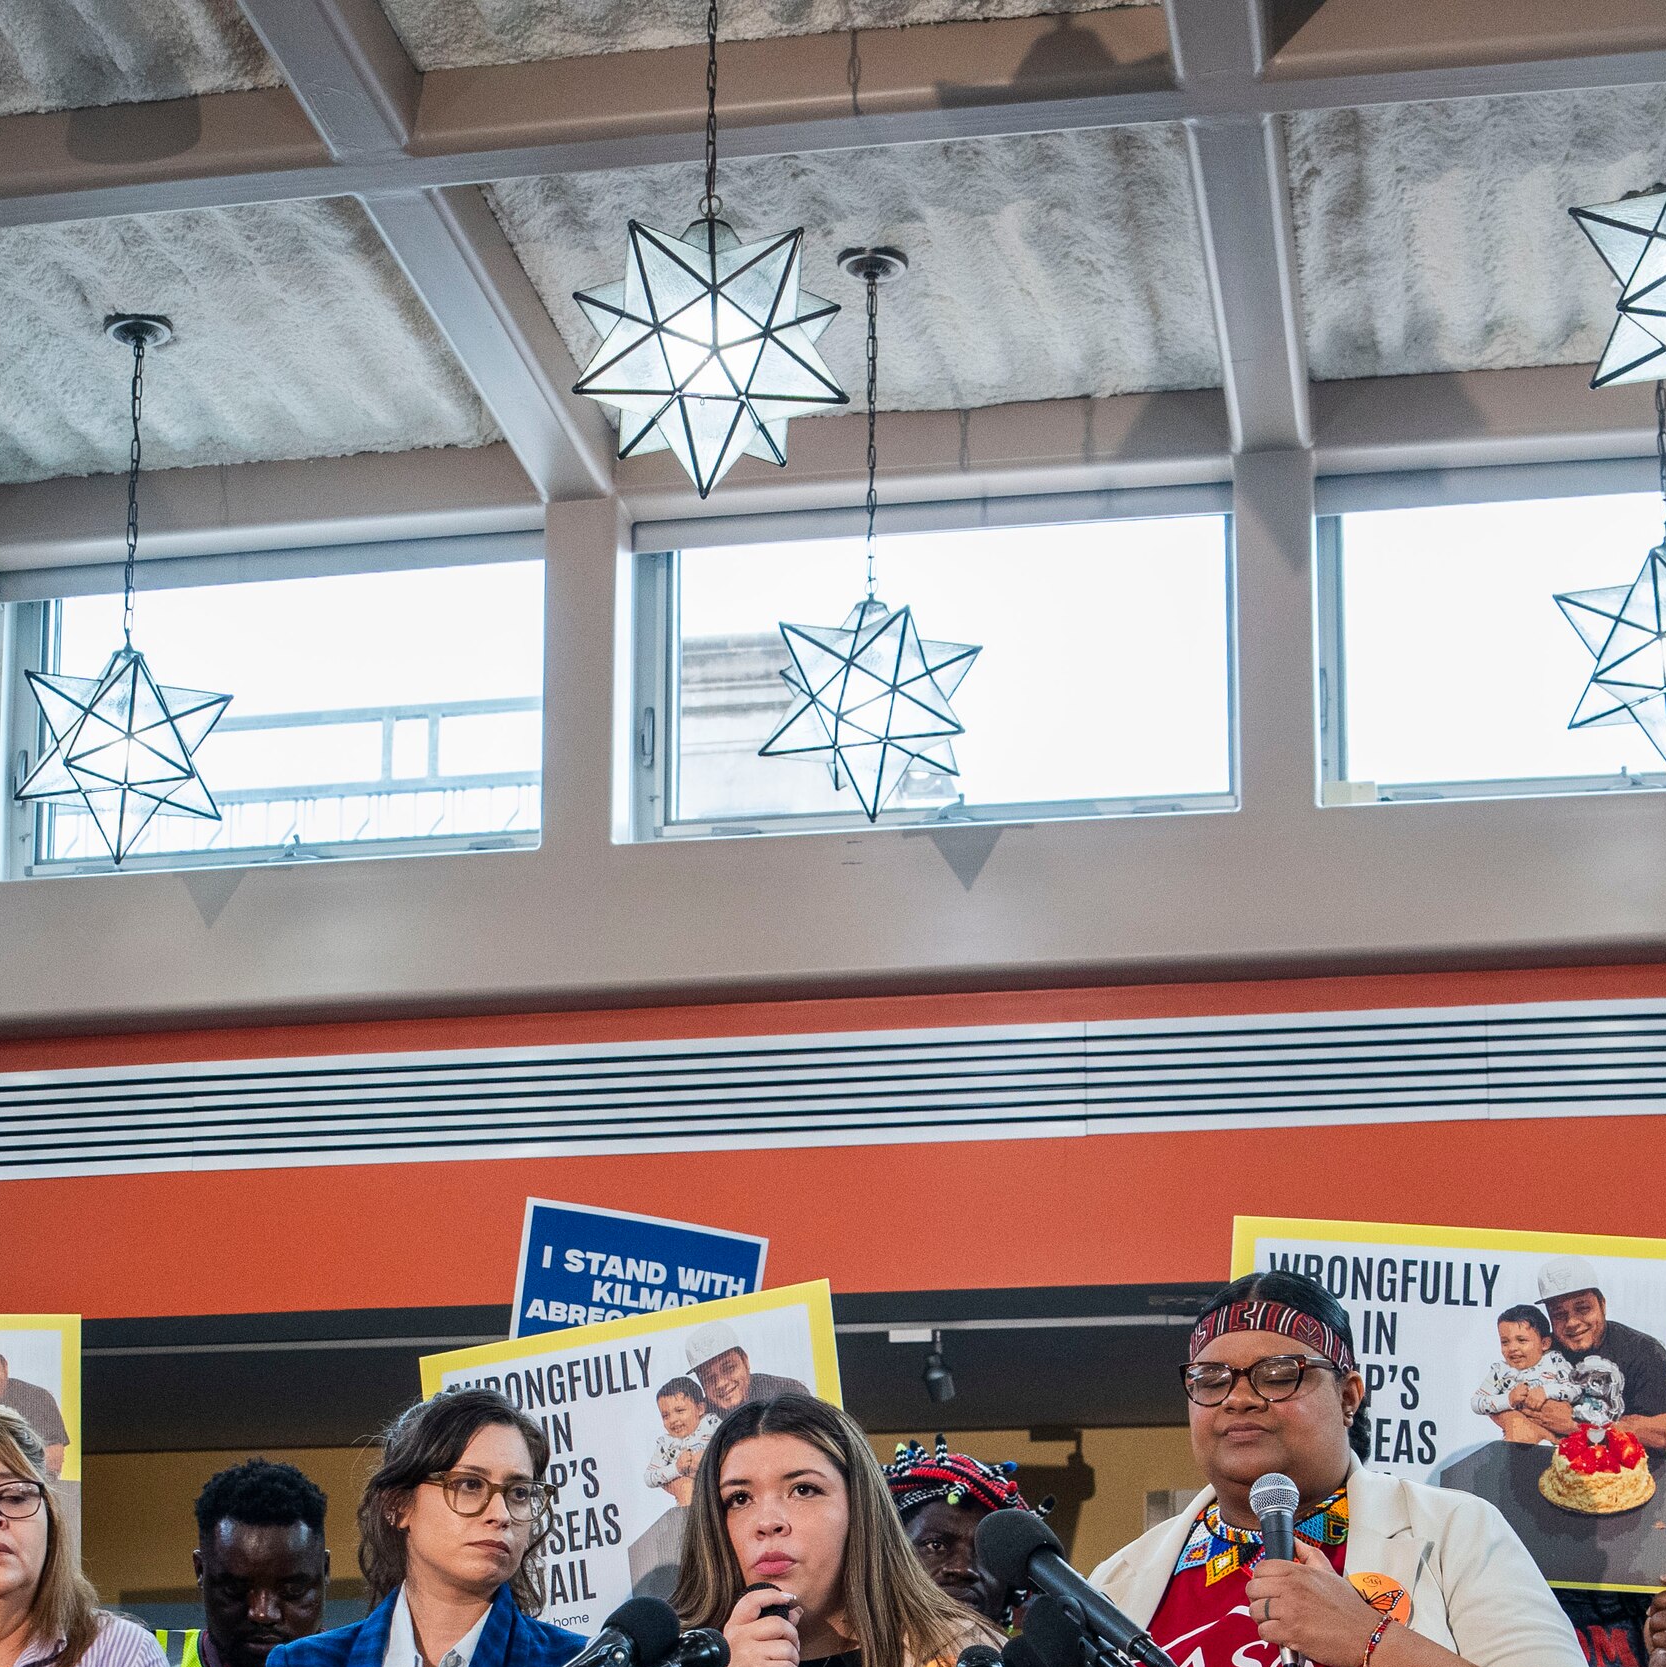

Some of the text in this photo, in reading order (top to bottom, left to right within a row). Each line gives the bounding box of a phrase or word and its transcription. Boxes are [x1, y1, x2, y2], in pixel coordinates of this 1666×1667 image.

[541, 1245, 747, 1297] I STAND WITH
[1362, 1310, 1397, 1355] IN
[550, 1560, 596, 1605] AIL
[553, 1612, 590, 1627] home
